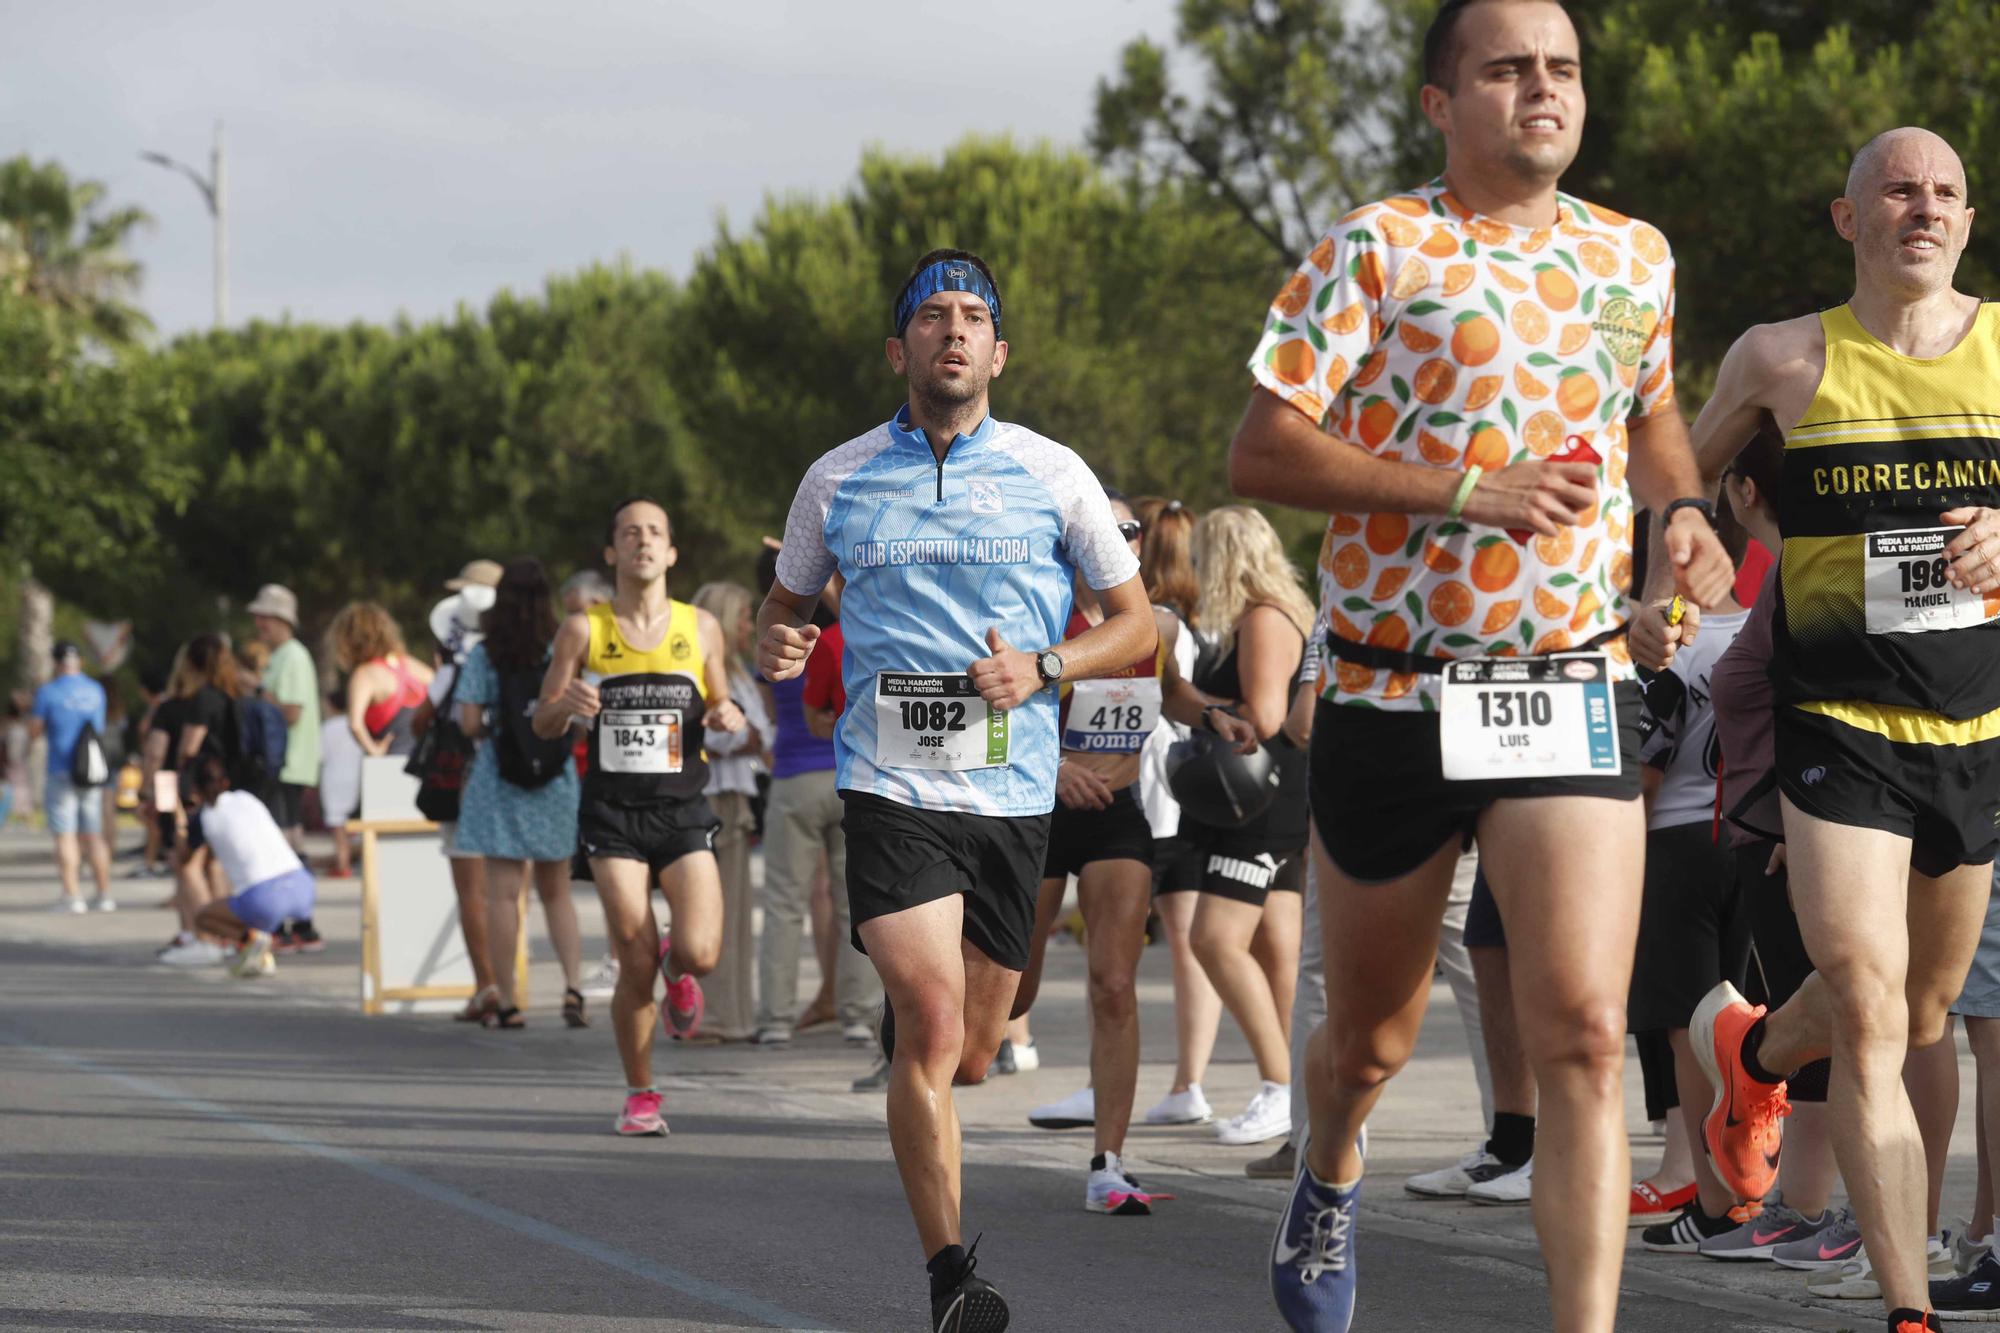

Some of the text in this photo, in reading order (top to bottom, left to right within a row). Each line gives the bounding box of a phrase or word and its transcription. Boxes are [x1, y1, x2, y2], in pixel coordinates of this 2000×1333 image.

[1877, 534, 1945, 546] MEDIA MARATÓN
[854, 537, 1029, 568] CLUB ESPORTIU L'ALCORA
[1877, 545, 1897, 553] VILA
[1911, 543, 1945, 552] PATERNA
[1904, 593, 1951, 608] MANUEL
[888, 678, 943, 687] MEDIA MARATÓN
[888, 685, 902, 693] VILA
[913, 686, 945, 694] PATERNA
[1478, 690, 1552, 727] 1310
[900, 701, 966, 731] 1082
[1089, 705, 1143, 731] 418
[613, 729, 655, 747] 1843
[917, 736, 945, 748] JOSE
[1499, 734, 1530, 747] LUIS
